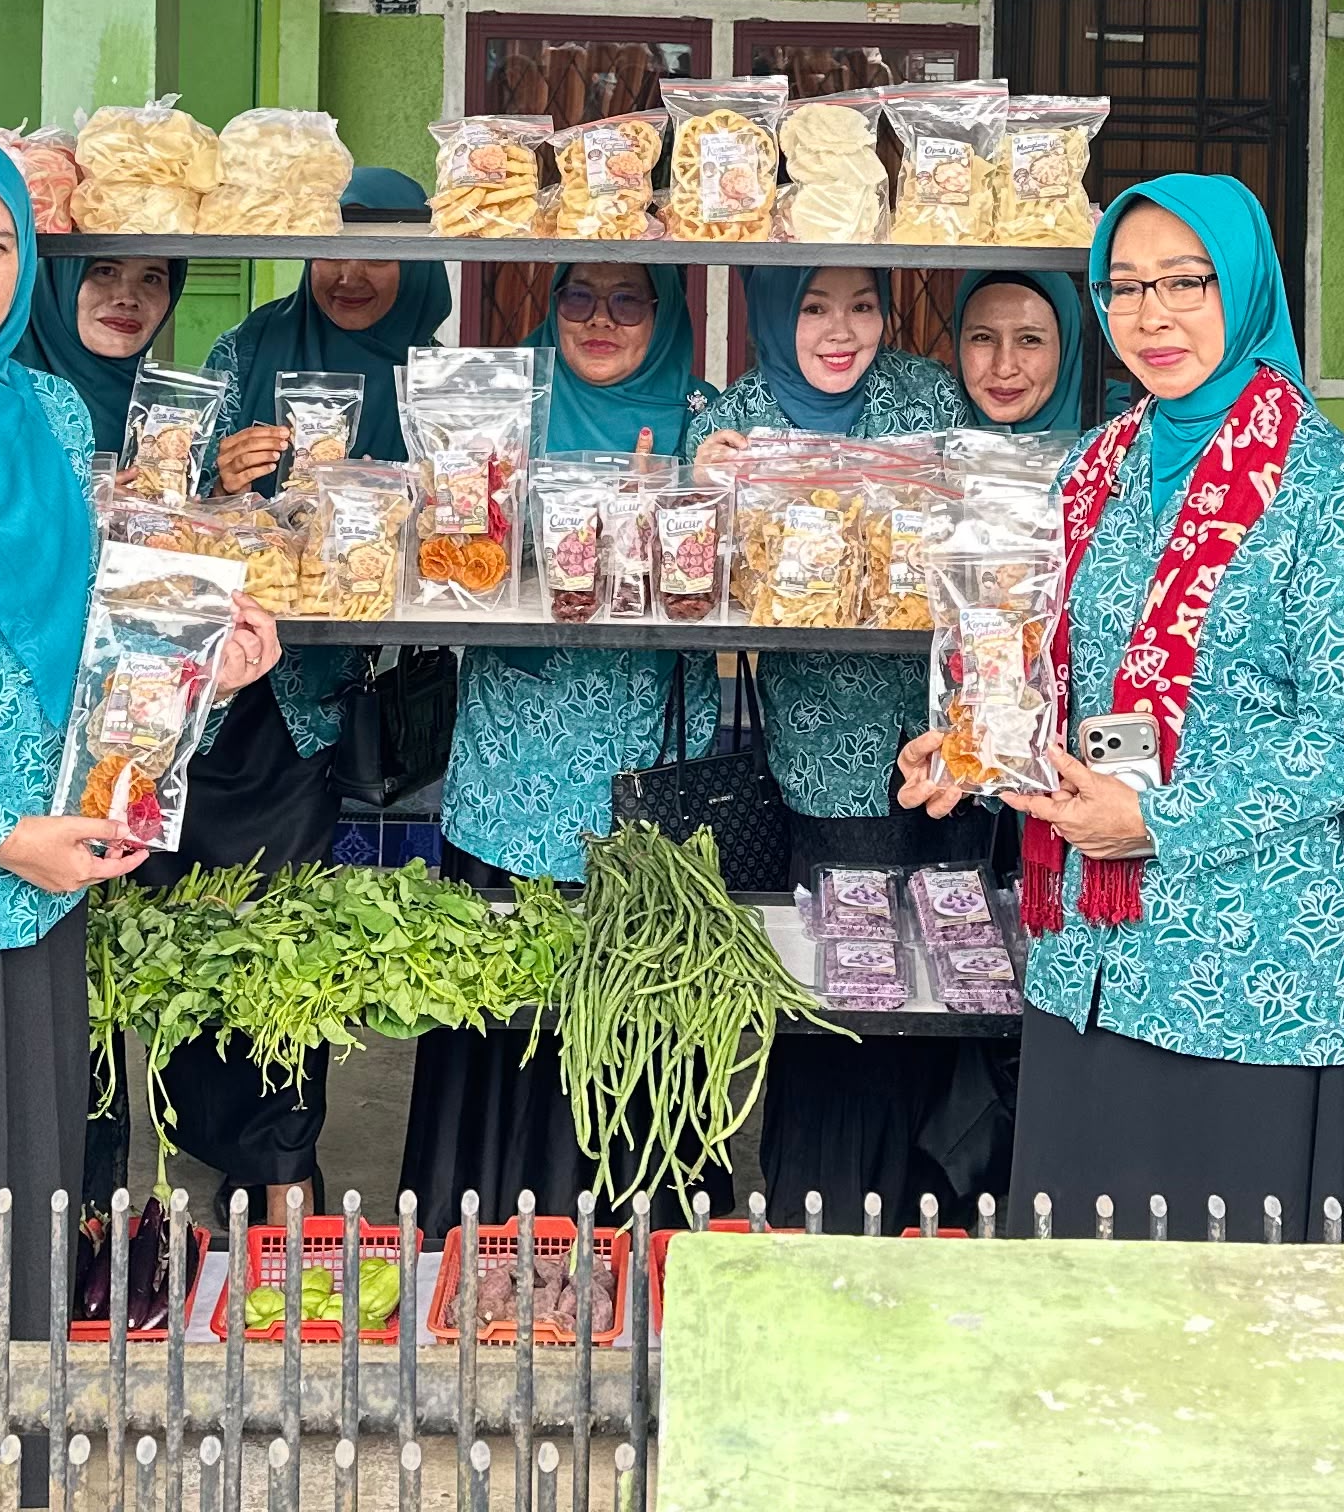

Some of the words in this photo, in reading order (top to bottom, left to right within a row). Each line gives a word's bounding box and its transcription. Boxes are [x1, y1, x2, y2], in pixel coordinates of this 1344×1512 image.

[605, 501, 642, 516] Cucur
[549, 514, 585, 528] Cucur
[666, 518, 703, 532] Cucur
[789, 517, 833, 535] Rmpeyek
